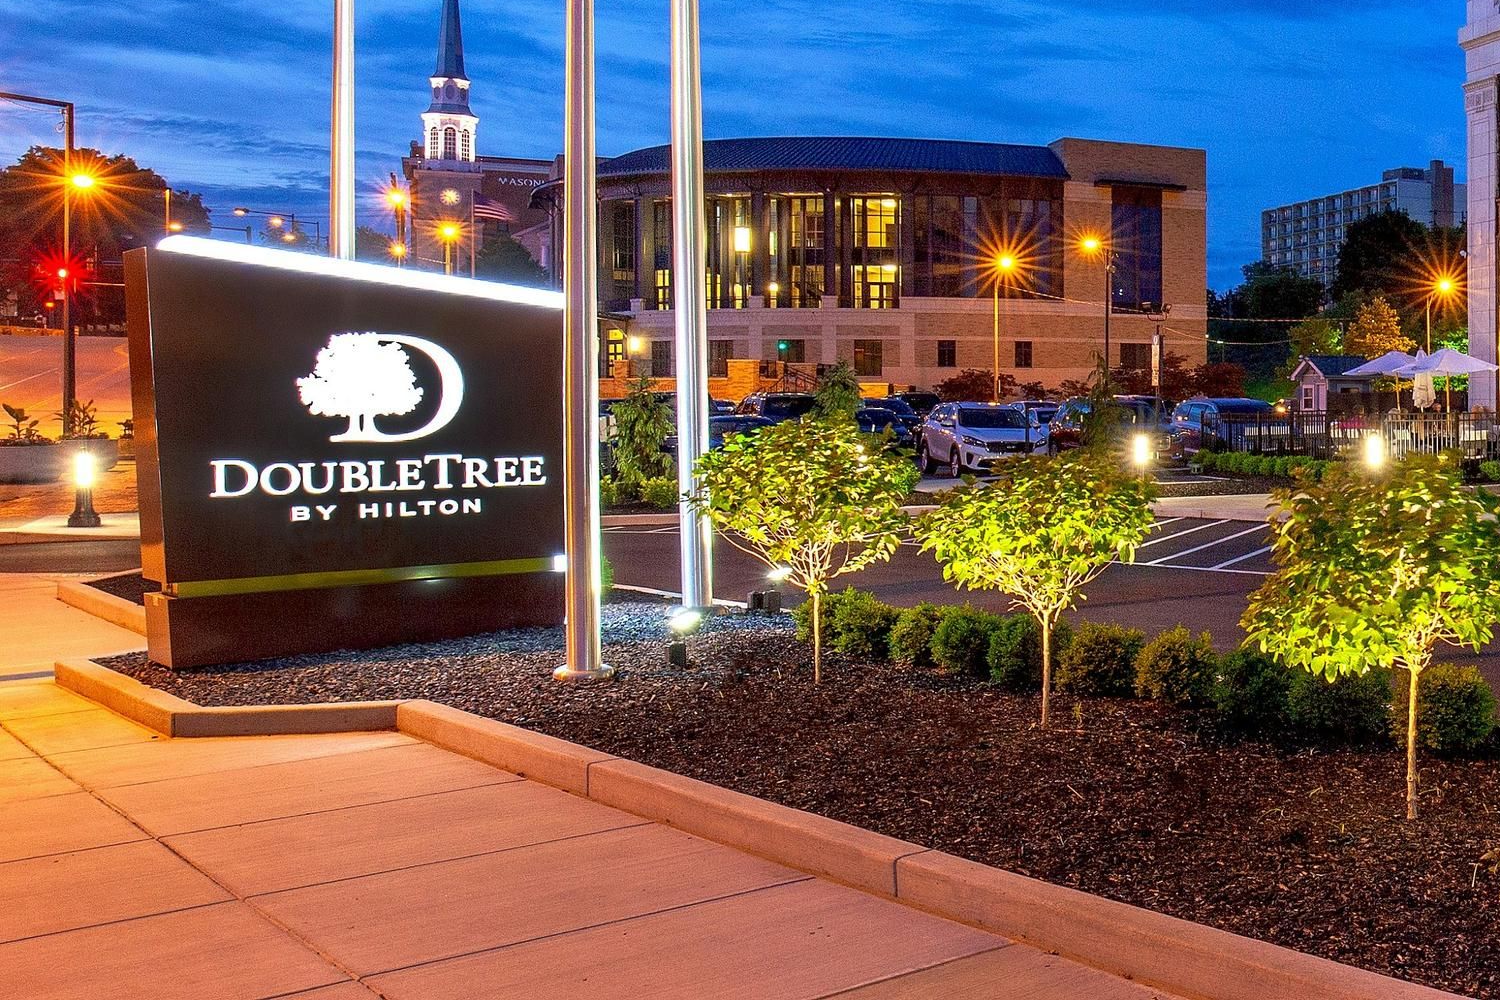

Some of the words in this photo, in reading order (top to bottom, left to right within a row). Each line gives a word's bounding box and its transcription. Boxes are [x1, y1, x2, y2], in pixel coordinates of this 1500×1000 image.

[209, 453, 547, 498] DOUBLETREE
[290, 504, 338, 522] BY
[359, 498, 482, 519] HILTON
